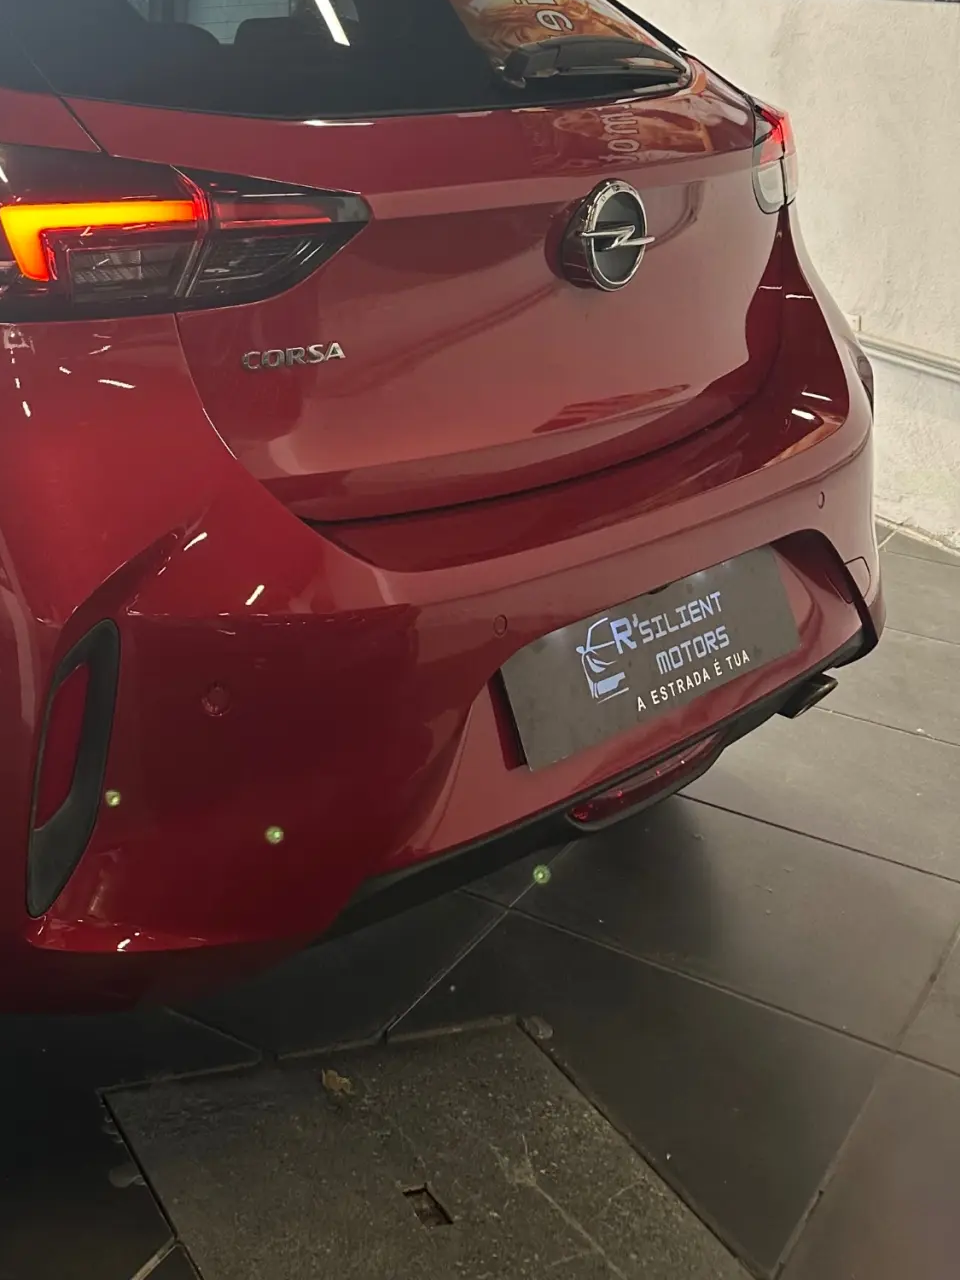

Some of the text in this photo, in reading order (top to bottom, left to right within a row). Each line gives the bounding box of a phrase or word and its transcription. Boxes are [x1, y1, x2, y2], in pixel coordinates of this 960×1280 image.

[242, 341, 346, 370] CORSA
[655, 625, 730, 675] MOTORS
[637, 649, 750, 712] A ESTRADA É TUA
